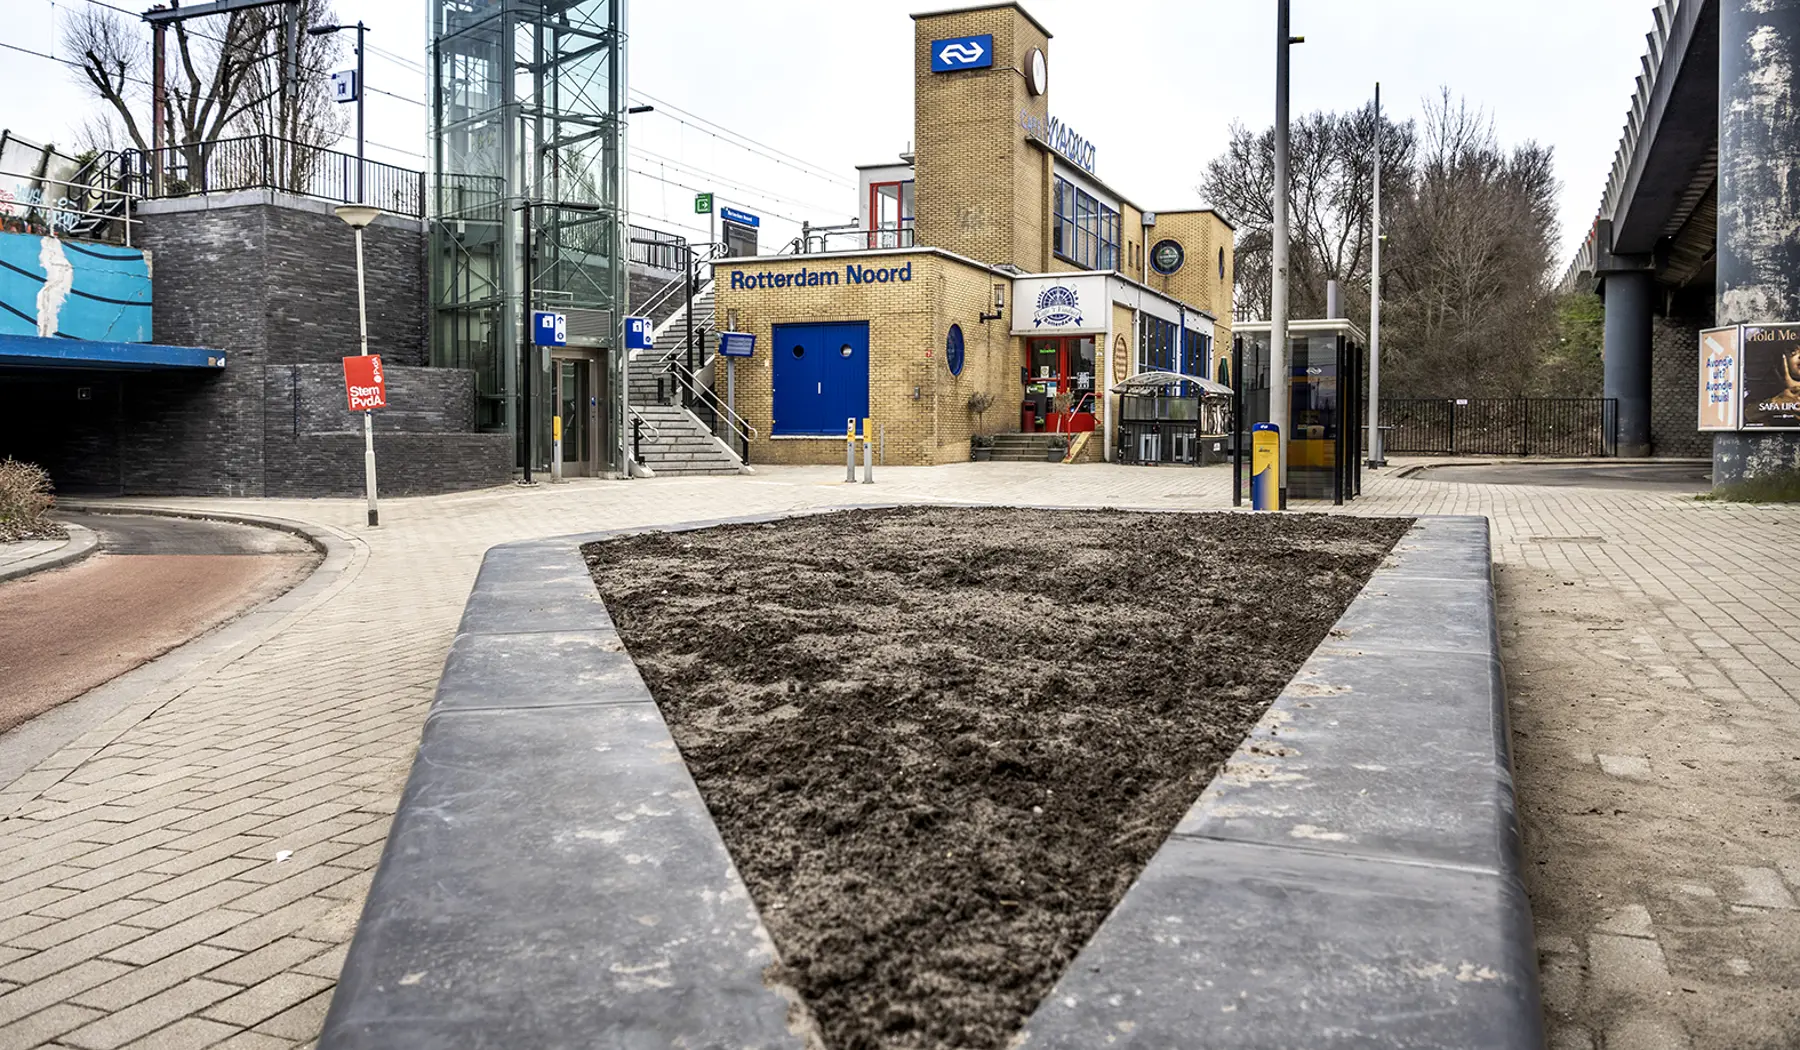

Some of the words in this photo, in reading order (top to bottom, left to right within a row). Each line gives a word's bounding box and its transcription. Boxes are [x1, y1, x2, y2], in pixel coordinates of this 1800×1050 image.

[731, 268, 839, 290] Rotterdam
[846, 261, 912, 285] Noord
[1778, 329, 1797, 341] Me
[371, 356, 380, 375] PvdA
[1706, 355, 1733, 369] Avondje
[1713, 368, 1727, 379] uit?
[349, 386, 380, 397] Stem
[1706, 380, 1732, 392] Avondje
[351, 394, 385, 408] PvdA.
[1758, 402, 1780, 411] SAFA
